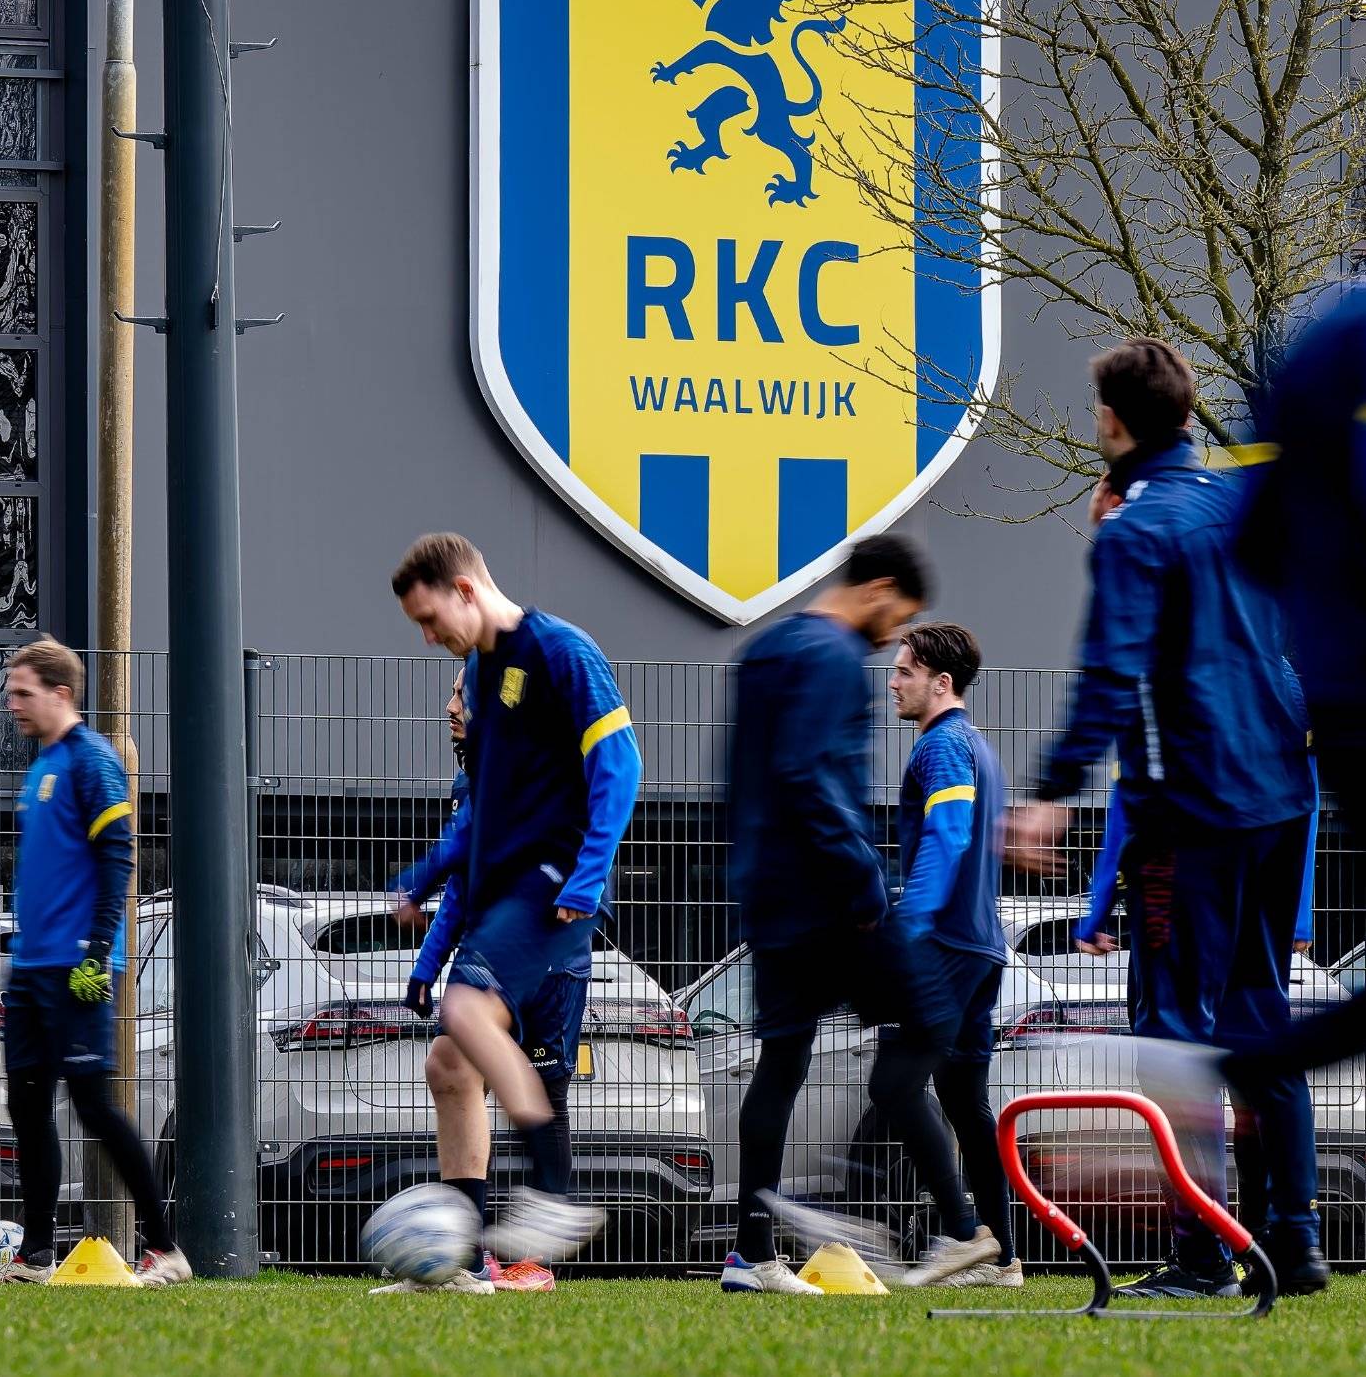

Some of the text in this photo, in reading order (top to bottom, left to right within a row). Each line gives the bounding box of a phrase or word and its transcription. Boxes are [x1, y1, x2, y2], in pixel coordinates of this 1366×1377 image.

[626, 235, 860, 347] RKC
[629, 375, 857, 420] WAALWIJK
[533, 1048, 546, 1057] 20
